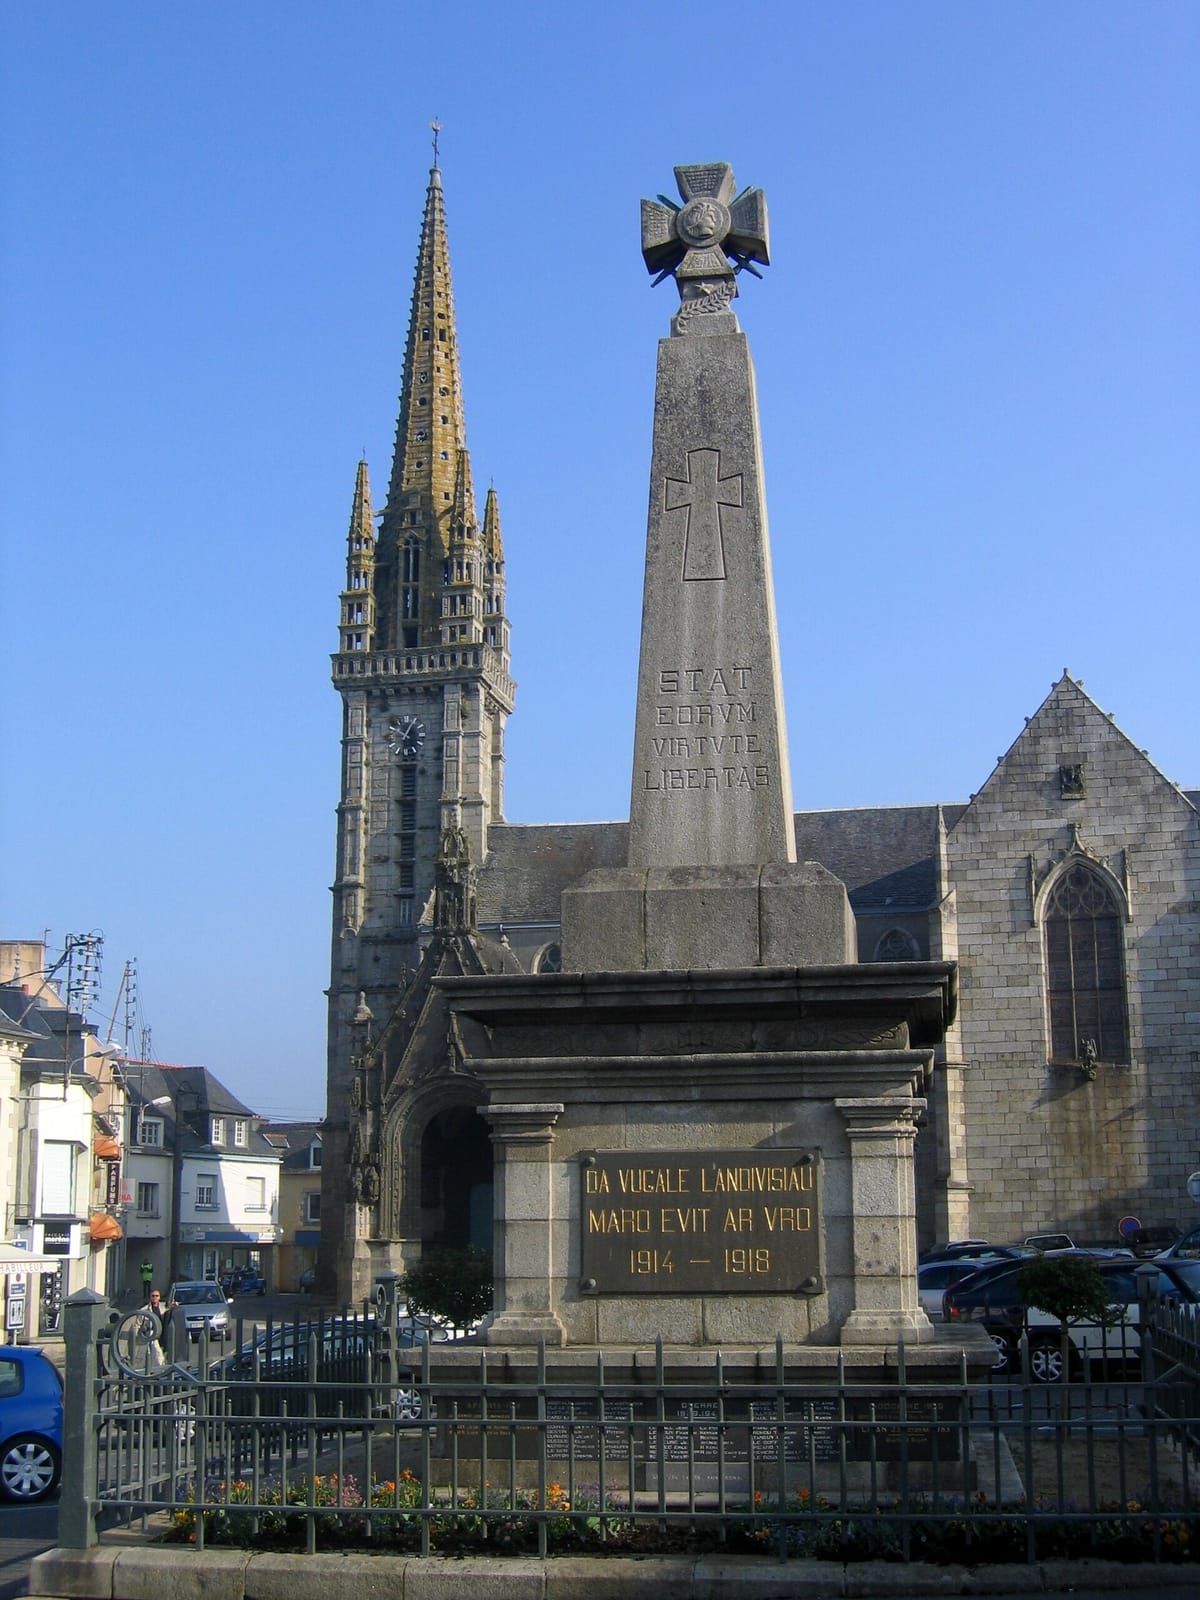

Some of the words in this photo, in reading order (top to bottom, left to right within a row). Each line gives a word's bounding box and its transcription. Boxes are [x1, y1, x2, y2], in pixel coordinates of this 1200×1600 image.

[658, 666, 752, 697] STAT
[655, 702, 757, 727] EORVM
[651, 735, 762, 758] VIRTVTE
[642, 766, 770, 792] LIBERTAS
[585, 1169, 611, 1194] DA
[618, 1168, 691, 1194] VUGALE
[701, 1167, 814, 1193] LANDIVISIAU
[588, 1208, 651, 1233] MARO
[660, 1208, 711, 1233] EVIT
[723, 1208, 753, 1233] AR
[764, 1206, 811, 1232] VRO
[629, 1249, 676, 1274] 1914
[724, 1248, 770, 1273] 1918
